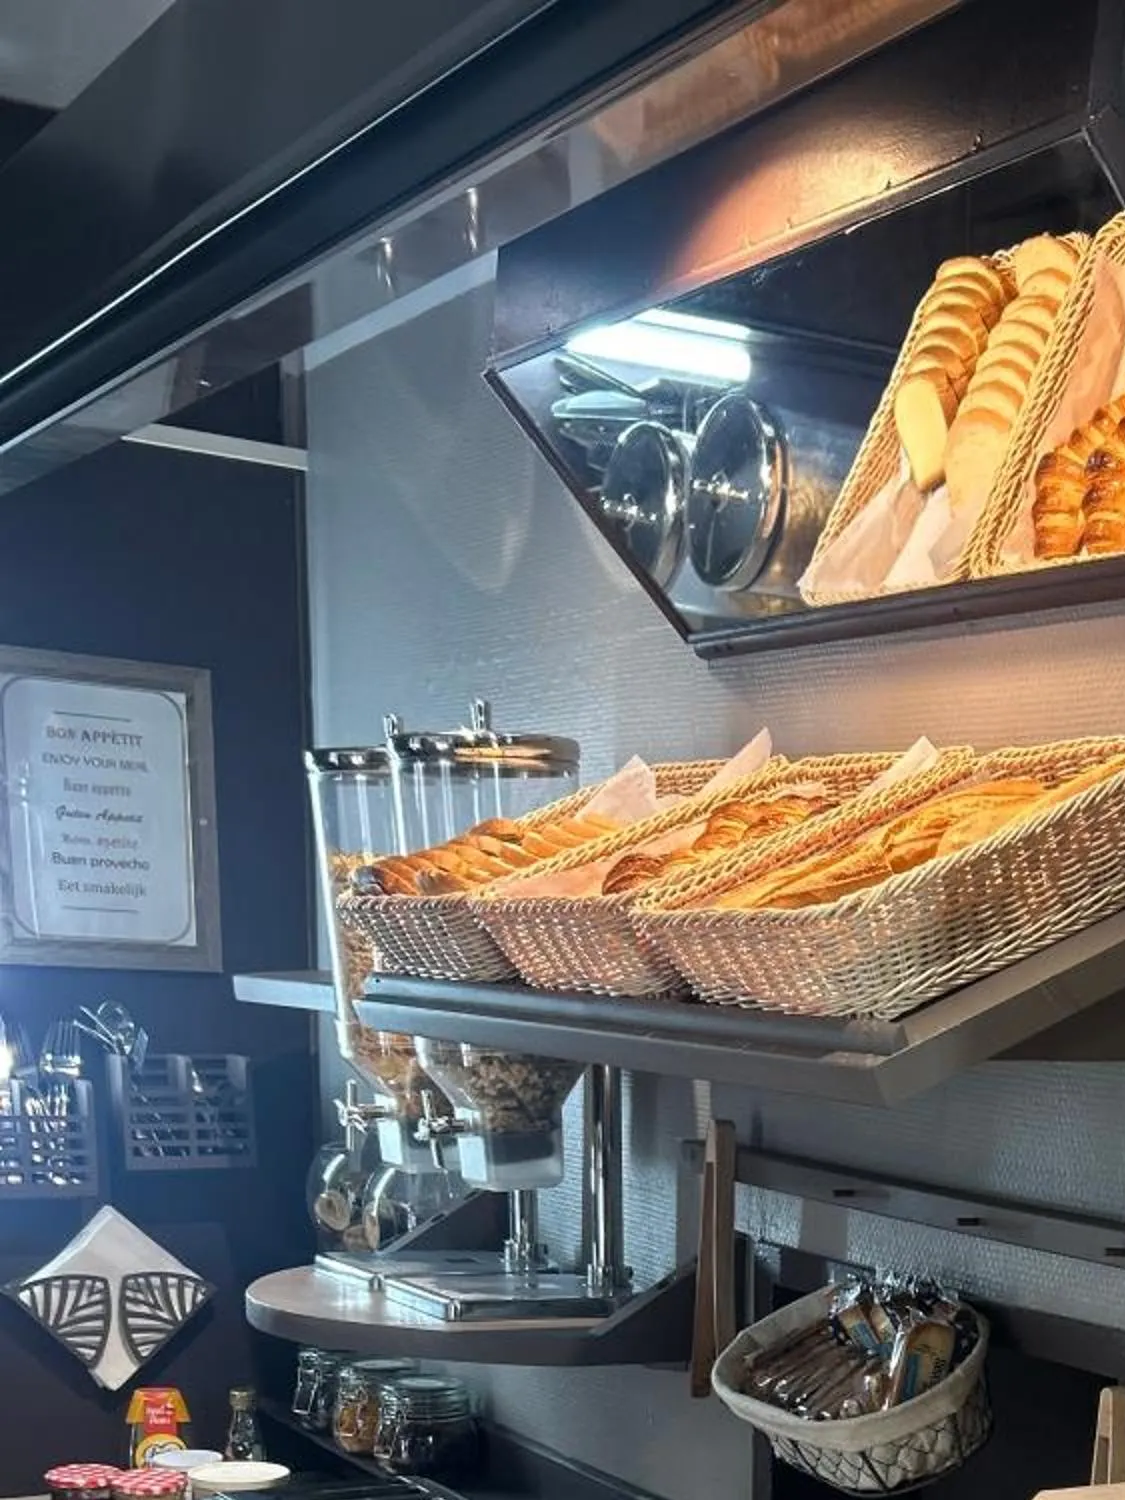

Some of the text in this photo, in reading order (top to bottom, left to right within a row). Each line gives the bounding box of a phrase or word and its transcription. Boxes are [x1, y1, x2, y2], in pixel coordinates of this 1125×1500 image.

[45, 725, 76, 741] BON
[41, 752, 80, 766] ENJOY
[82, 755, 117, 769] YOUR
[51, 851, 151, 872] Buen provecho
